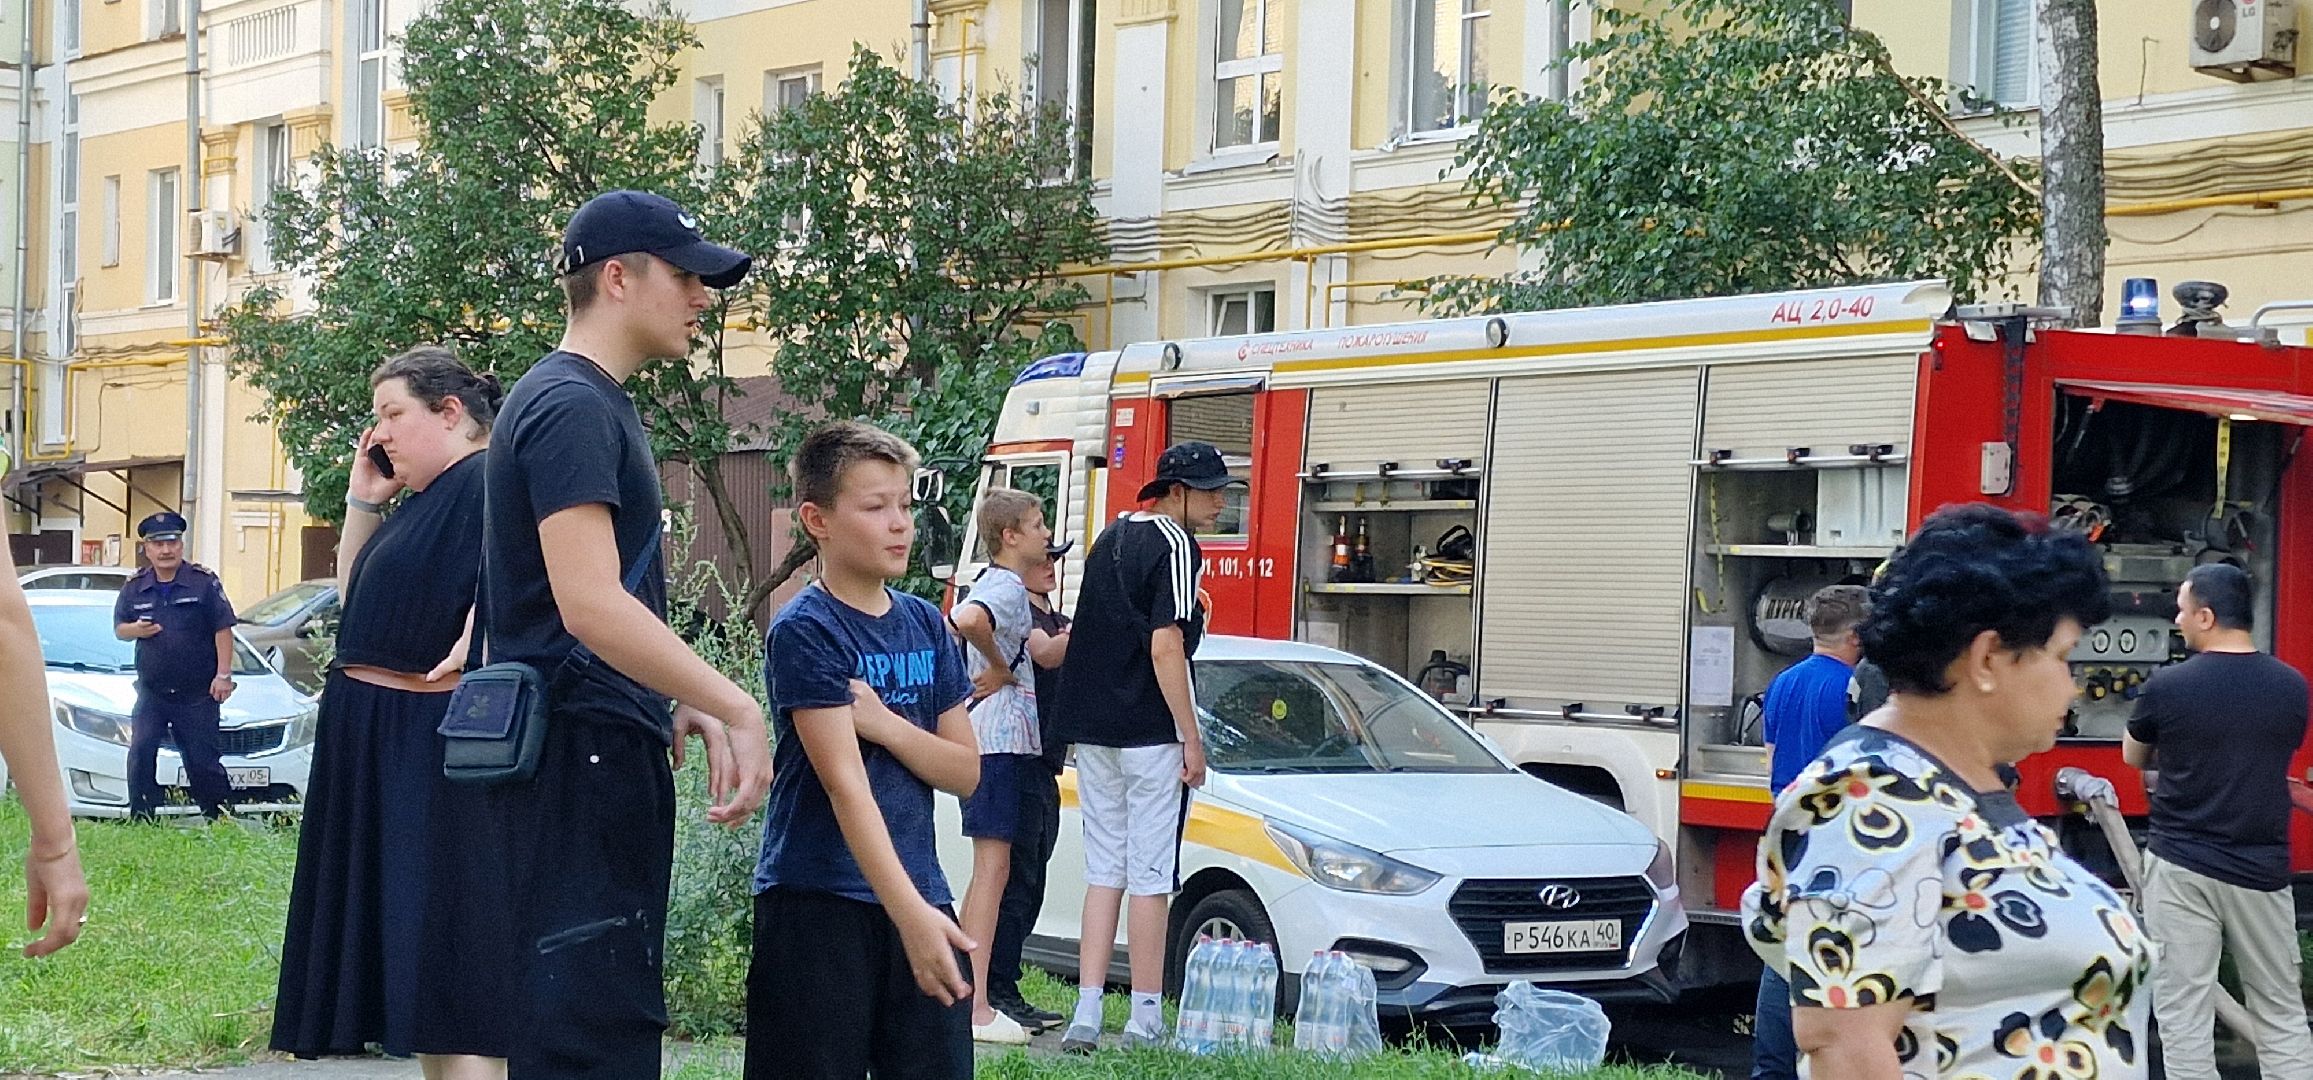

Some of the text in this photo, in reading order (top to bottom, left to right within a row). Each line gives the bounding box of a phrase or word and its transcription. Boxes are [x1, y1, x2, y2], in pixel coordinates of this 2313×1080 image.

[2242, 6, 2256, 18] LG
[1771, 296, 1874, 325] АЦ 2,0-40
[1251, 331, 1429, 355] СПЕЦТЕХНИКА ПОЖАРОТУШЕНИЯ
[1219, 556, 1243, 579] 101,
[249, 769, 264, 780] 05
[1597, 922, 1614, 941] 40
